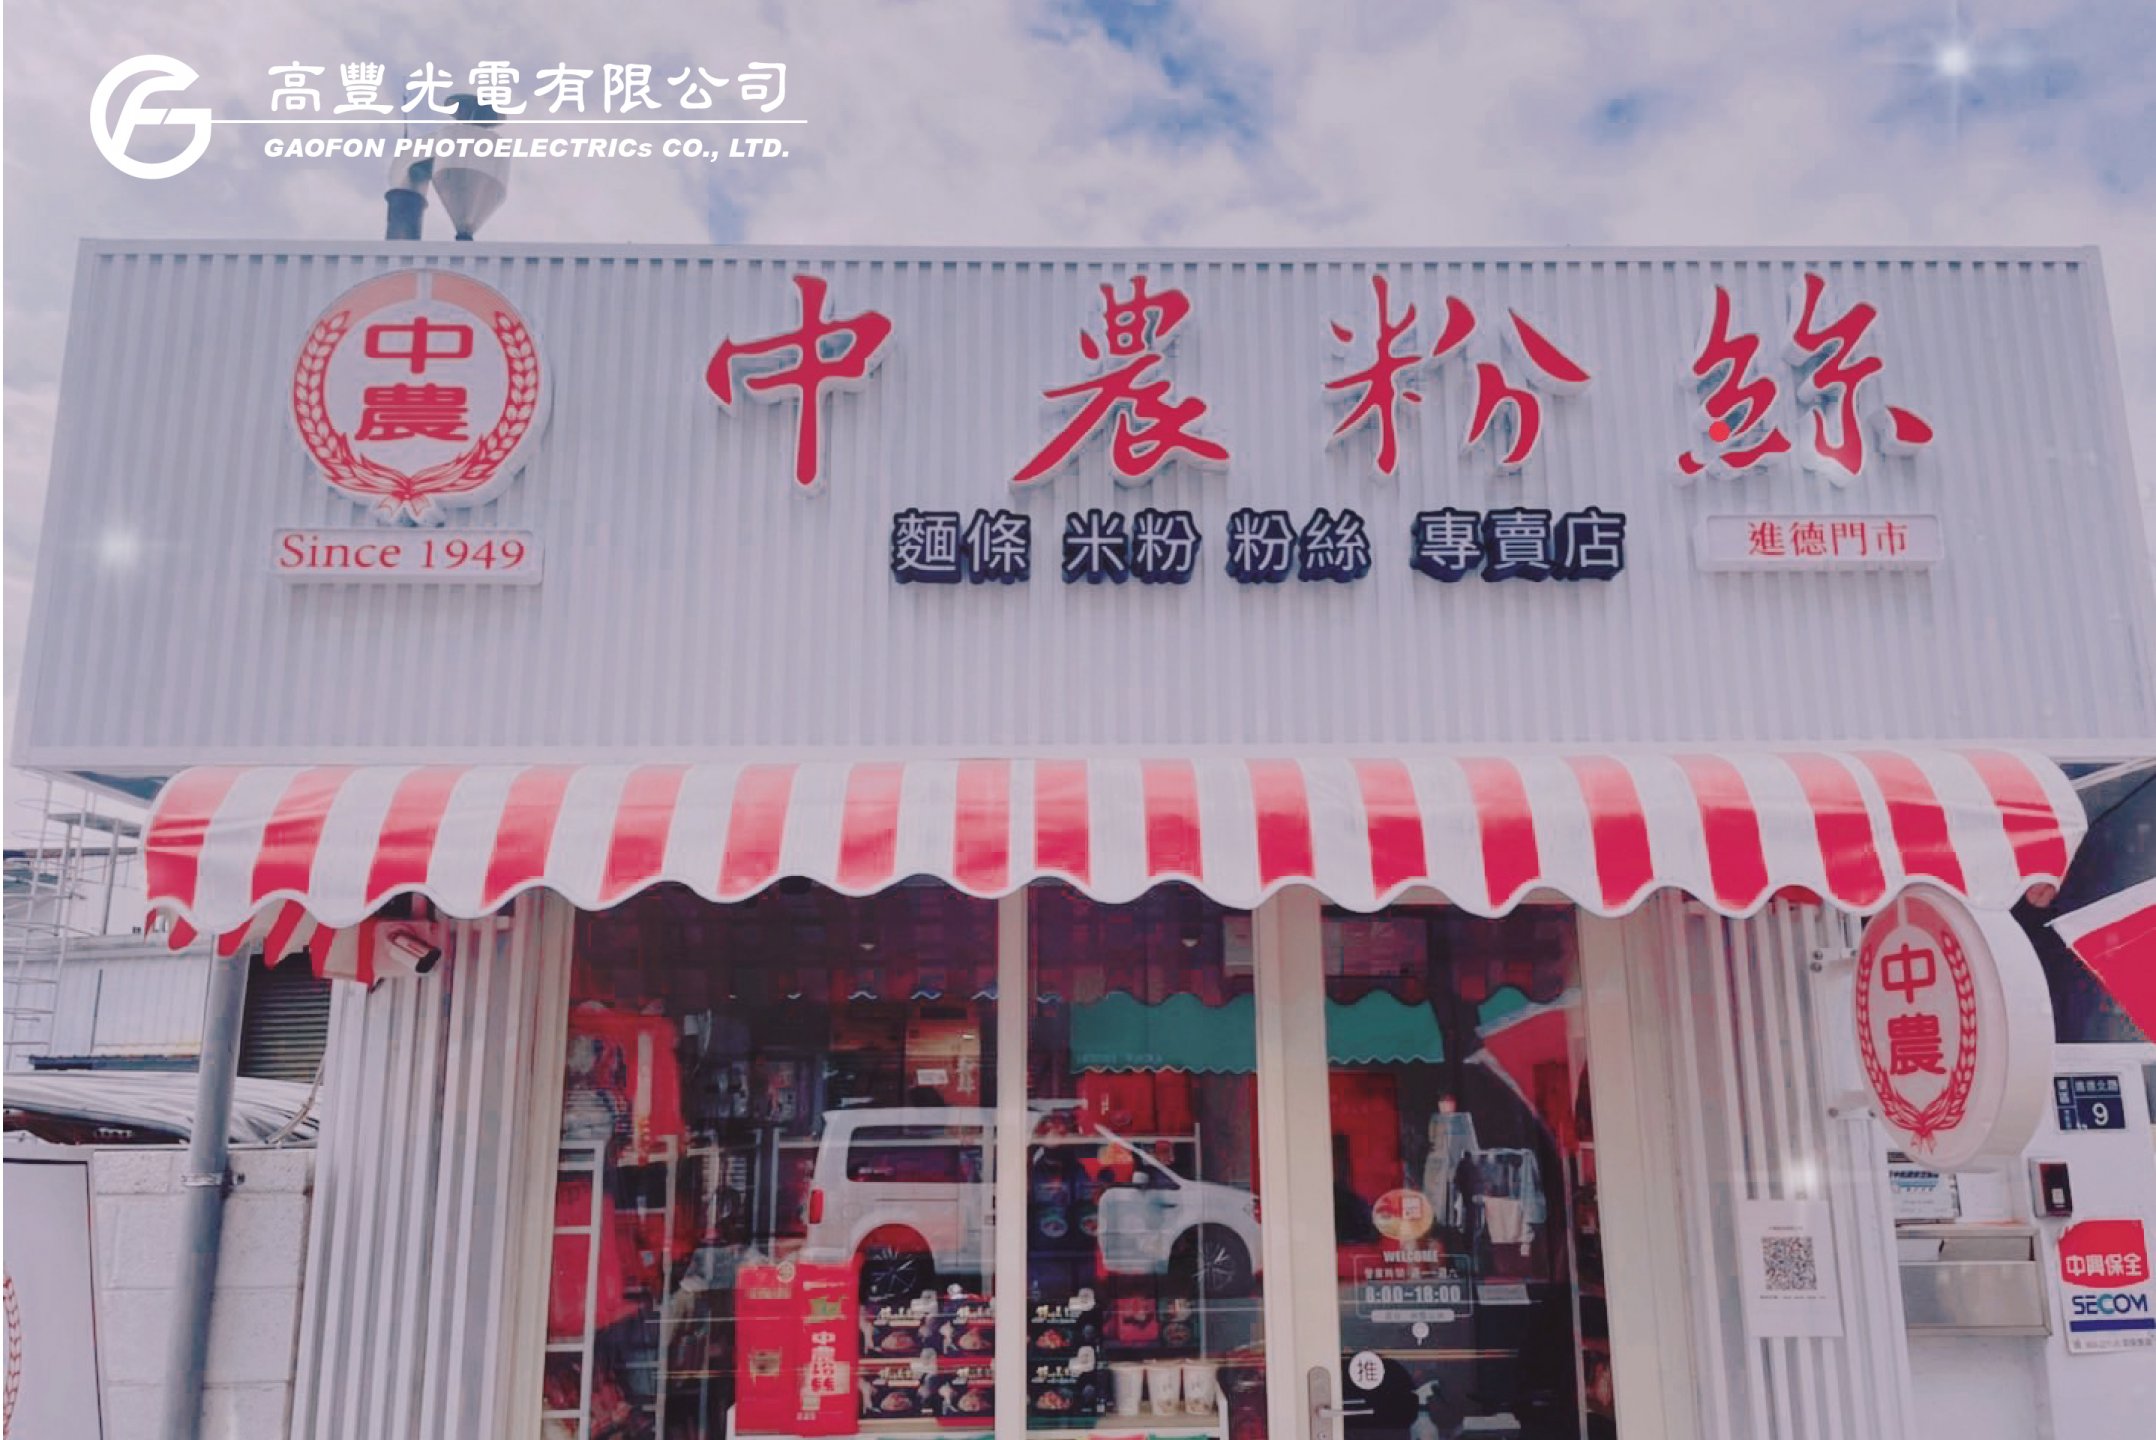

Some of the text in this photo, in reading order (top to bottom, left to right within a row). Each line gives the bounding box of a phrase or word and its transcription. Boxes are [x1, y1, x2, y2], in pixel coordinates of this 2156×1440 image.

[355, 316, 474, 443] 中農
[706, 272, 1933, 488] 中農粉絲
[280, 534, 526, 571] Since 1949
[893, 509, 1624, 580] 麵條 米粉 粉絲 專賣店
[1749, 521, 1908, 557] 進德門市
[1880, 942, 1947, 1077] 中農
[2091, 1103, 2110, 1126] 9
[2072, 1293, 2149, 1315] SECOM
